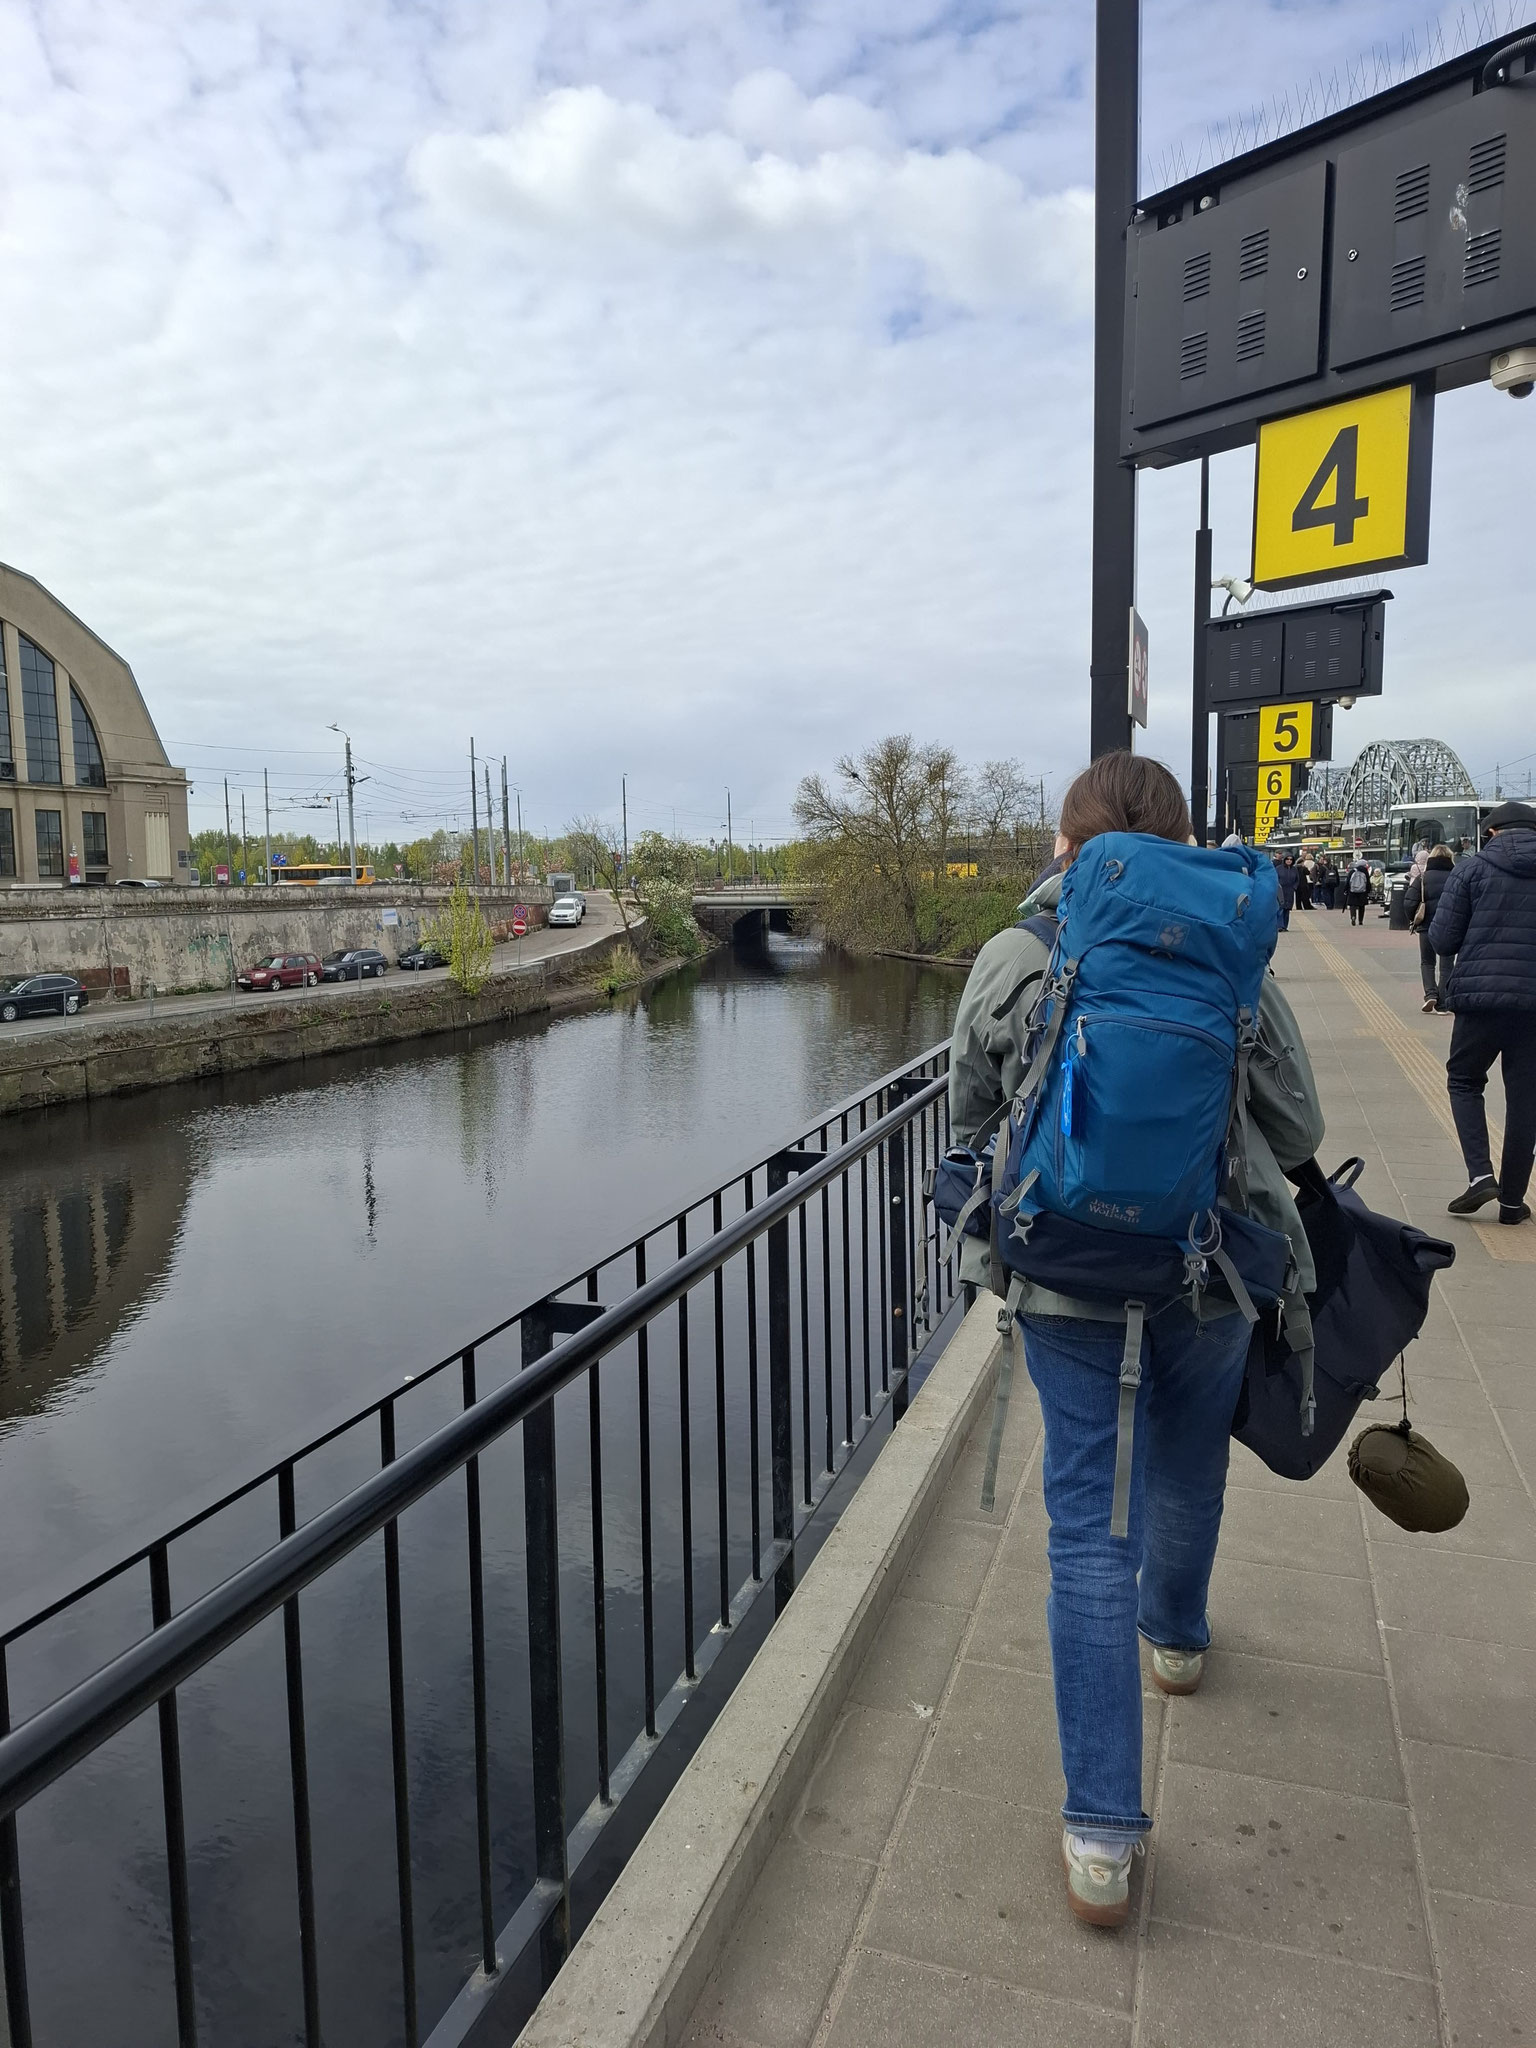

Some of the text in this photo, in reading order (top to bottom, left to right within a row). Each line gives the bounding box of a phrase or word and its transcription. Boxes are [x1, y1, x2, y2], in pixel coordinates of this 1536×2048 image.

[1292, 424, 1369, 546] 4
[1273, 711, 1299, 752] 5
[1266, 770, 1282, 795] 6
[1089, 1203, 1140, 1223] Wolfskin
[1090, 1198, 1120, 1213] Jack
